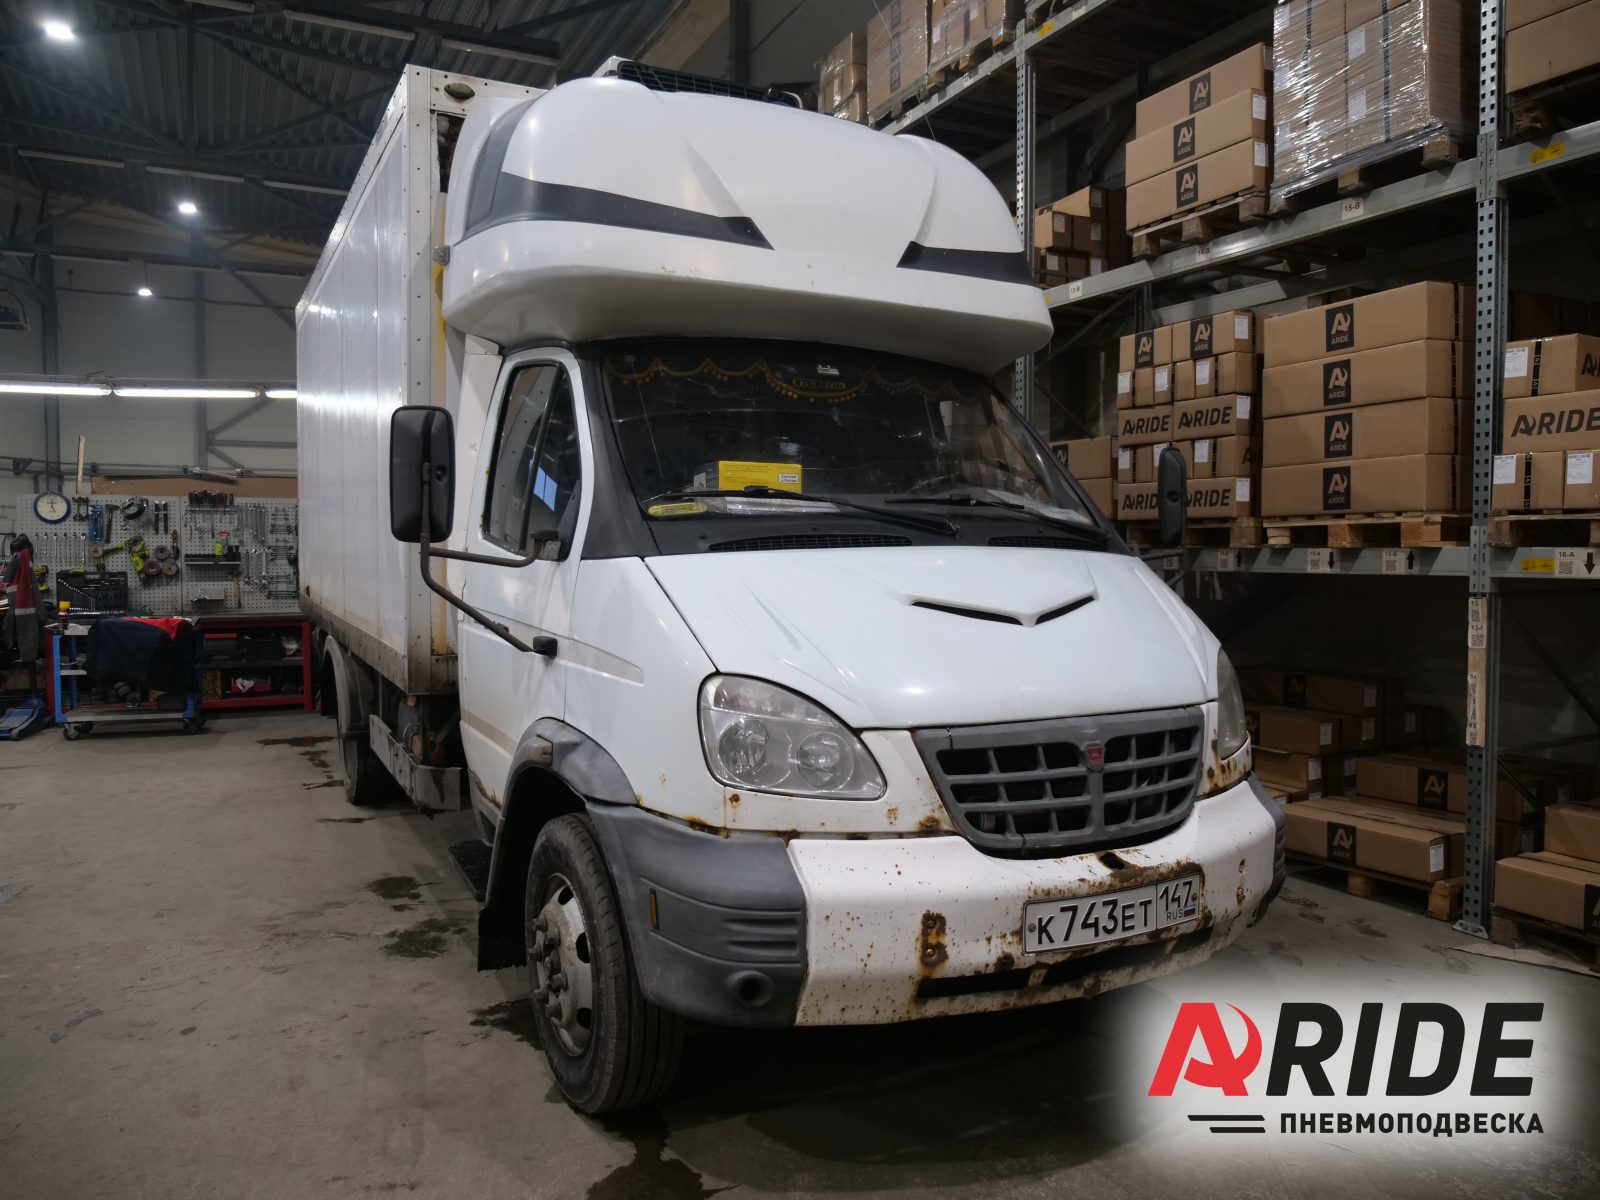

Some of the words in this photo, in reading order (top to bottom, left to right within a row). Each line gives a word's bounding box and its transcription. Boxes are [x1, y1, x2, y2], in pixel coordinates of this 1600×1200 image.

[1194, 343, 1209, 351] ARIDE
[1331, 335, 1349, 345] ARIDE
[1328, 390, 1346, 399] ARIDE
[1177, 406, 1232, 429] ARIDE
[1511, 396, 1600, 437] ARIDE
[1122, 415, 1171, 436] ARIDE
[1329, 443, 1347, 452] ARIDE
[1122, 493, 1159, 510] ARID
[1187, 489, 1231, 507] RIDE
[1328, 496, 1345, 504] ARIDE
[1159, 879, 1193, 912] 147
[1166, 908, 1184, 922] RUS
